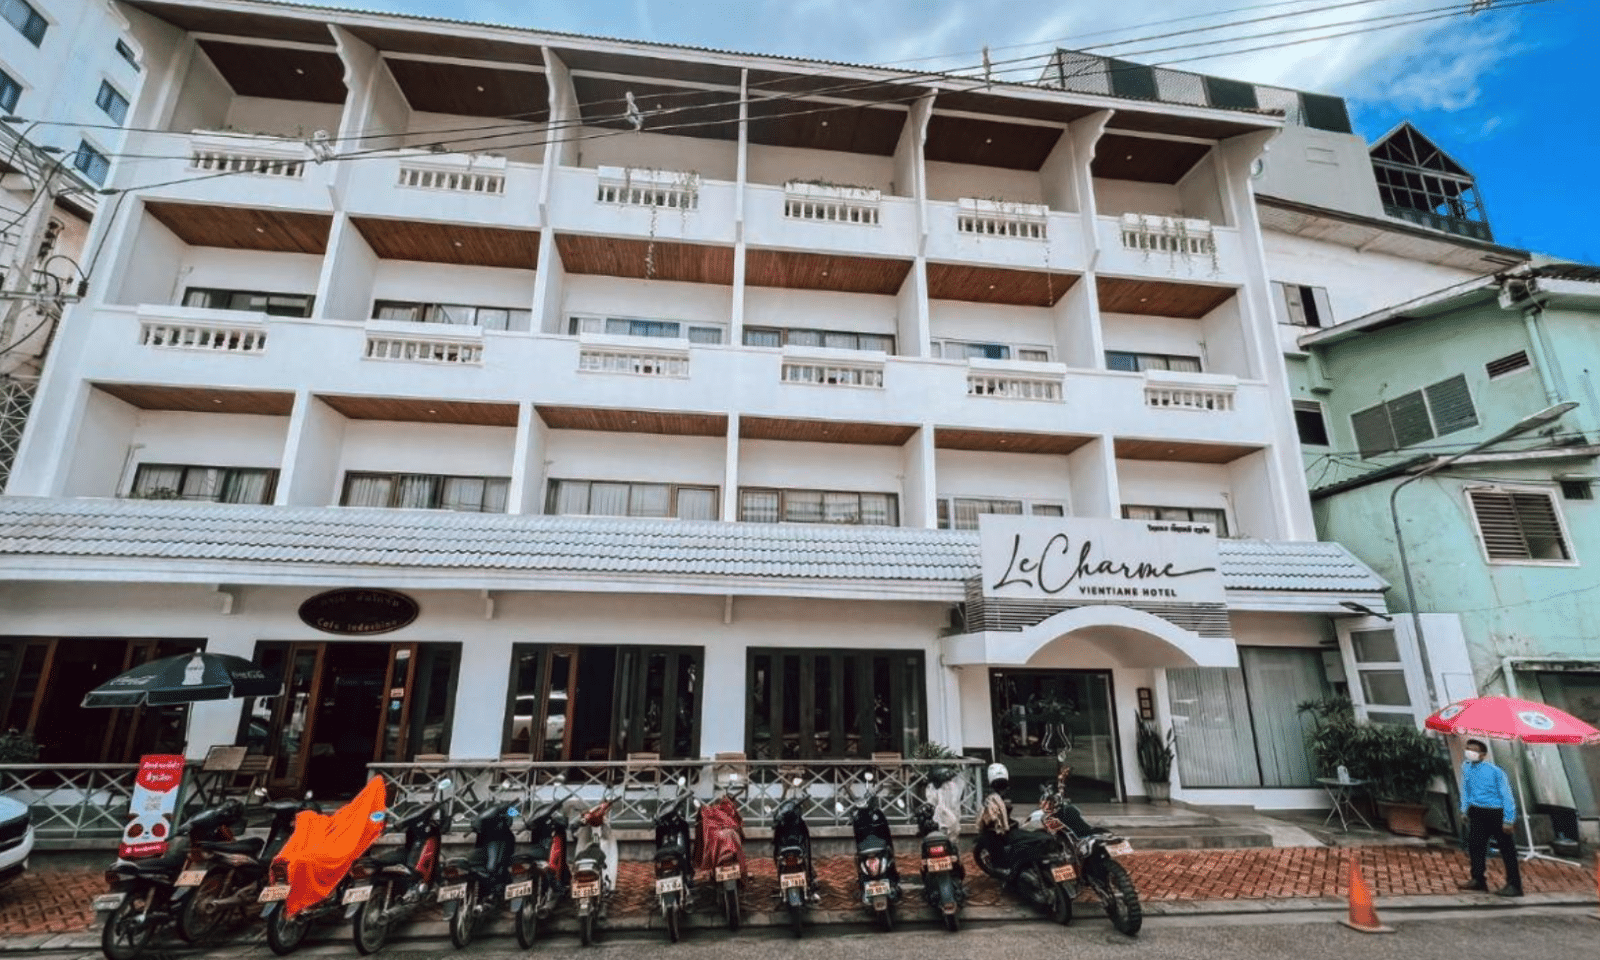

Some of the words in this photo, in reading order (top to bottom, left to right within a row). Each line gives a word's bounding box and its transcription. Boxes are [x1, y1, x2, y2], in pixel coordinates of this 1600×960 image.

[992, 533, 1039, 590] Le
[1037, 533, 1216, 594] Charme
[1079, 585, 1139, 597] VIENTIANE
[1142, 587, 1178, 598] HOTEL
